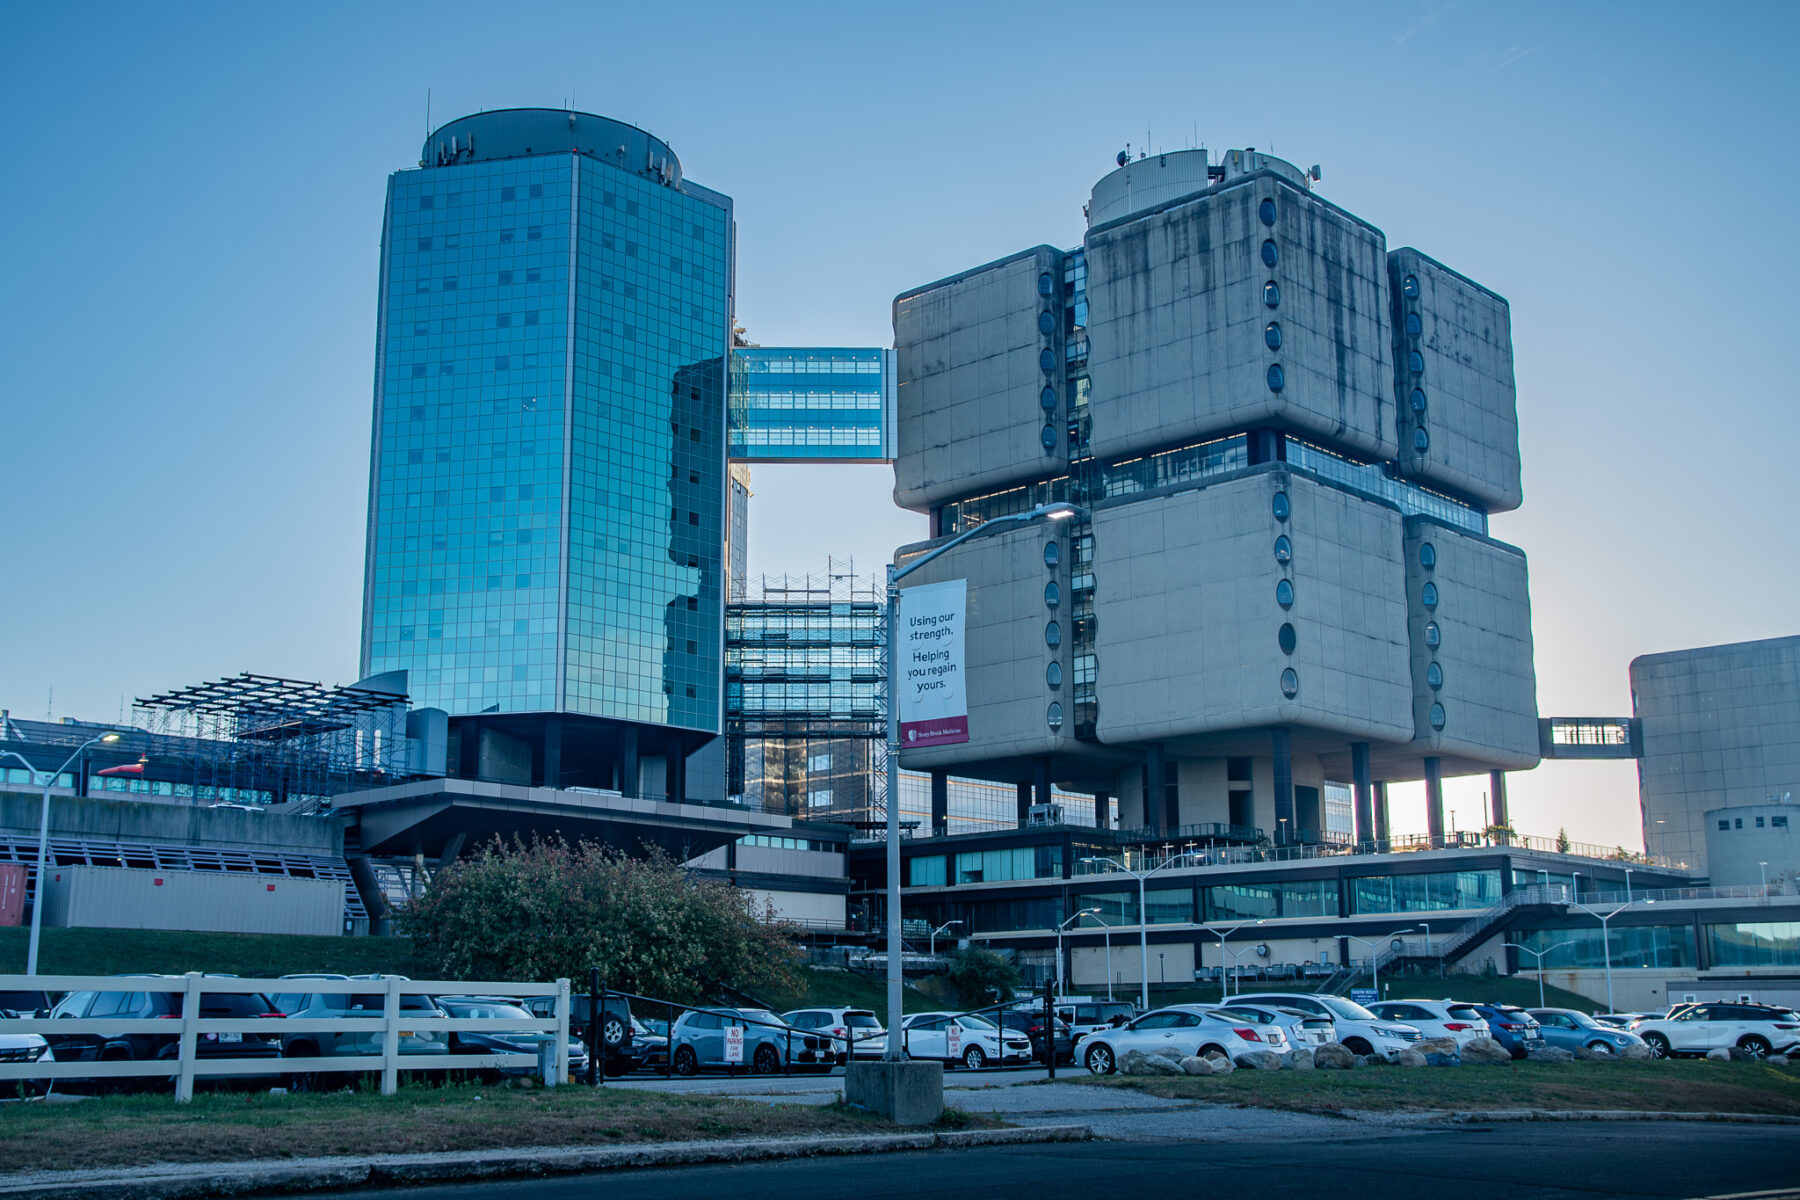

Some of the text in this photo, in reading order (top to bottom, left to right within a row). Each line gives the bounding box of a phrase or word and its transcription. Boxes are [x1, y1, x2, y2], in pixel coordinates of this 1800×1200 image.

[910, 613, 955, 627] Using our
[910, 626, 954, 641] strength.
[913, 649, 950, 663] Helping
[907, 662, 957, 681] you regain
[916, 680, 947, 694] yours.
[731, 1029, 739, 1037] NO
[951, 1027, 957, 1035] NO
